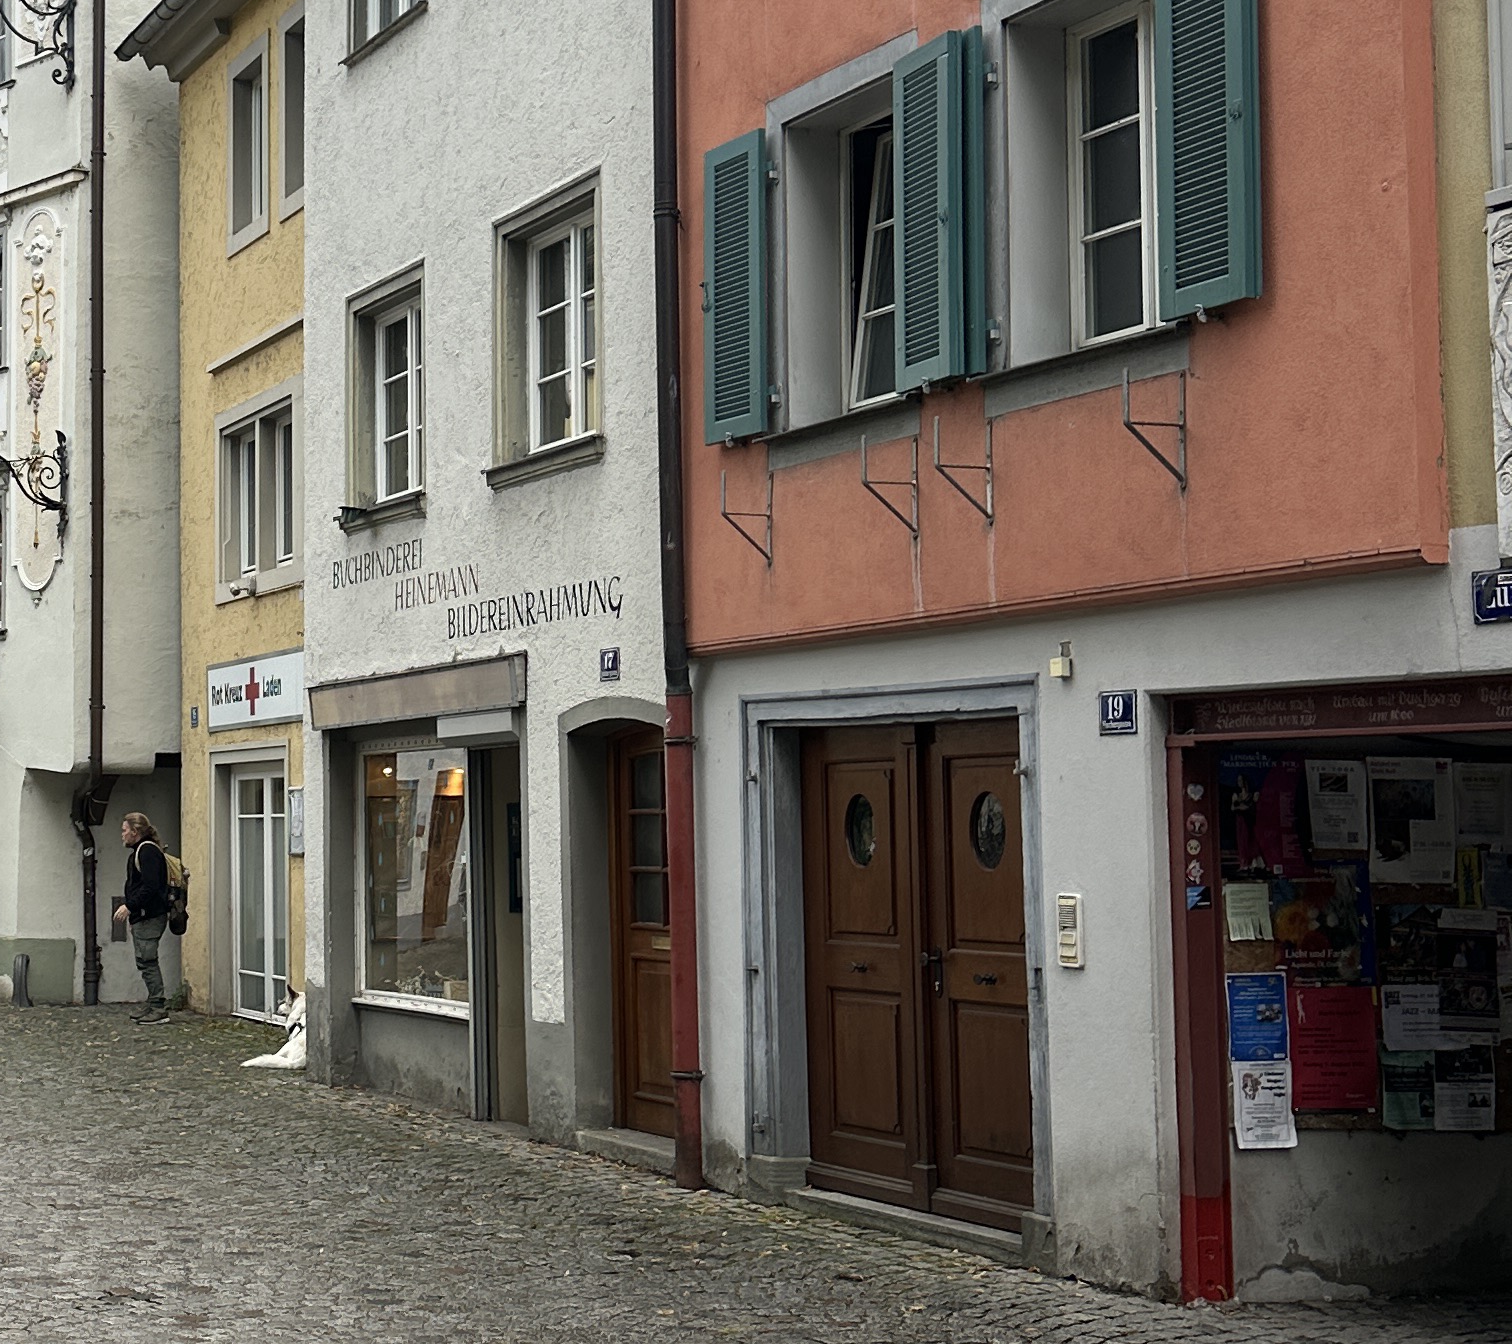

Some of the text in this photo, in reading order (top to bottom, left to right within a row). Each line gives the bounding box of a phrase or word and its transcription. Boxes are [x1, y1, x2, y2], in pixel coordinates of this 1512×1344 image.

[332, 538, 423, 589] BUCHBINDEREI
[395, 563, 480, 612] HEINEMANN
[448, 576, 623, 640] BILDEREINRAHMUNG
[603, 651, 615, 671] 17
[211, 675, 282, 706] Rot Kreuz Laden
[1107, 695, 1124, 719] 19
